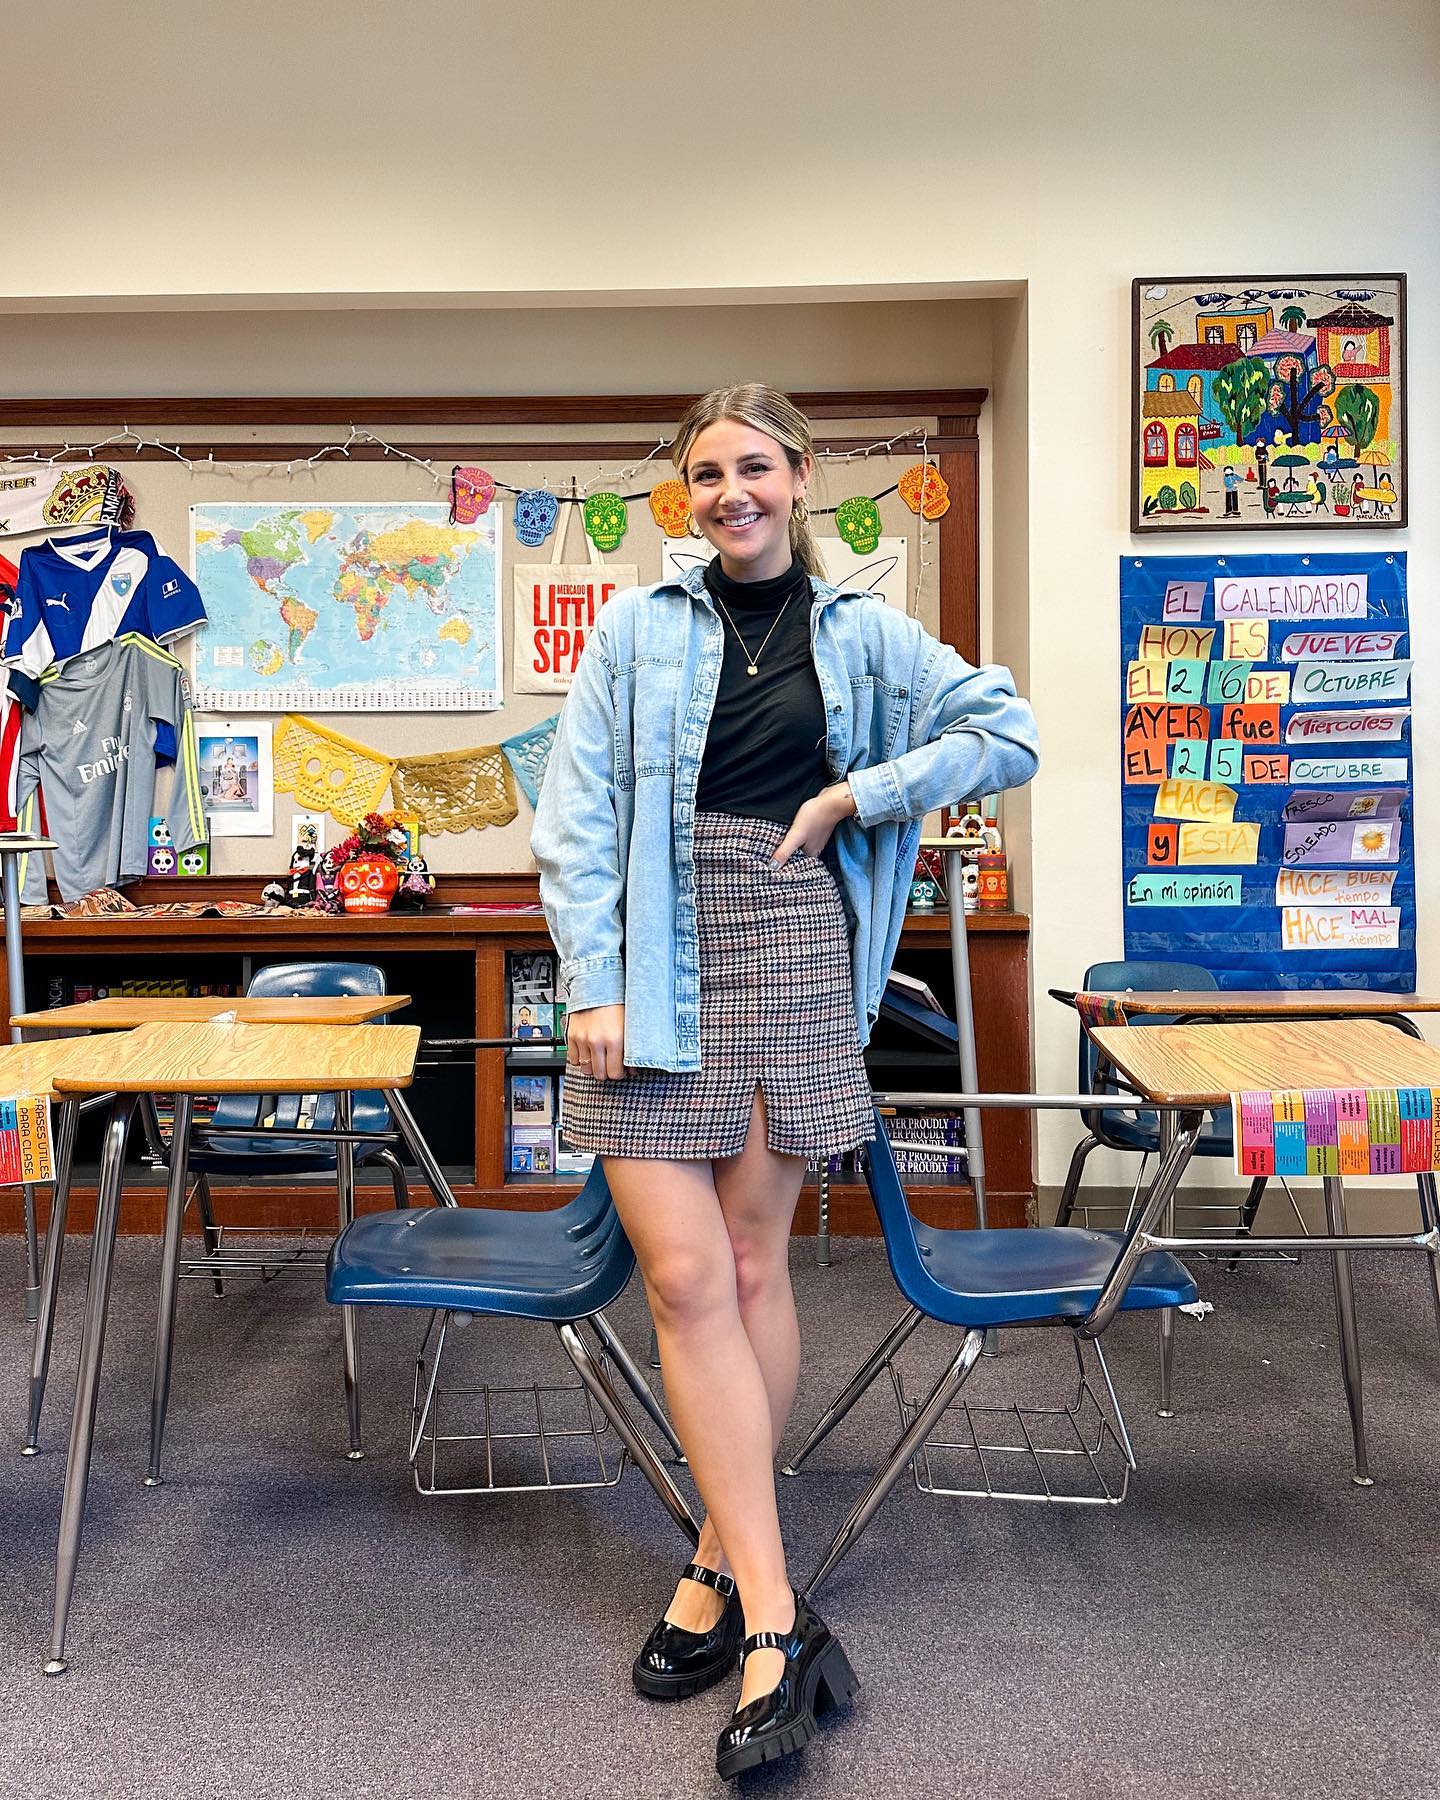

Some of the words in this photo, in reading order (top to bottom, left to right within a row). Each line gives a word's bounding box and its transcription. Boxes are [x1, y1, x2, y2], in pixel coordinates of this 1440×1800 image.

[557, 584, 586, 595] MERCADO
[1165, 585, 1200, 614] EL
[1221, 582, 1359, 614] CALENDARIO
[1143, 627, 1213, 659] HOY
[1229, 622, 1266, 659] ES
[1286, 634, 1397, 656] JUEVES
[1129, 665, 1163, 698] EL
[1248, 677, 1282, 699] DE
[1304, 668, 1399, 692] OCTUBRE
[1126, 706, 1203, 739] AYER
[1226, 708, 1274, 739] fue
[1288, 716, 1394, 736] Miercoles
[1127, 749, 1163, 776] EL
[1251, 759, 1285, 780] DE
[1295, 763, 1383, 778] OCTUBRE
[1160, 781, 1232, 815] HACE
[1285, 794, 1334, 820] FRESCO
[1285, 823, 1337, 863] SOLEADO
[1129, 881, 1153, 903] En
[1184, 881, 1234, 902] opinión
[1279, 870, 1339, 897] HACE
[1346, 871, 1393, 887] BUEN
[1335, 890, 1380, 904] tiempo
[1285, 909, 1344, 945] HACE
[1351, 910, 1395, 925] MAL
[1349, 932, 1392, 945] tiempo
[20, 1107, 30, 1137] PARA
[906, 1129, 945, 1139] PROUDLY
[908, 1118, 949, 1129] PROUDLY
[23, 1140, 33, 1175] CLASE
[907, 1162, 949, 1173] PROUDLY
